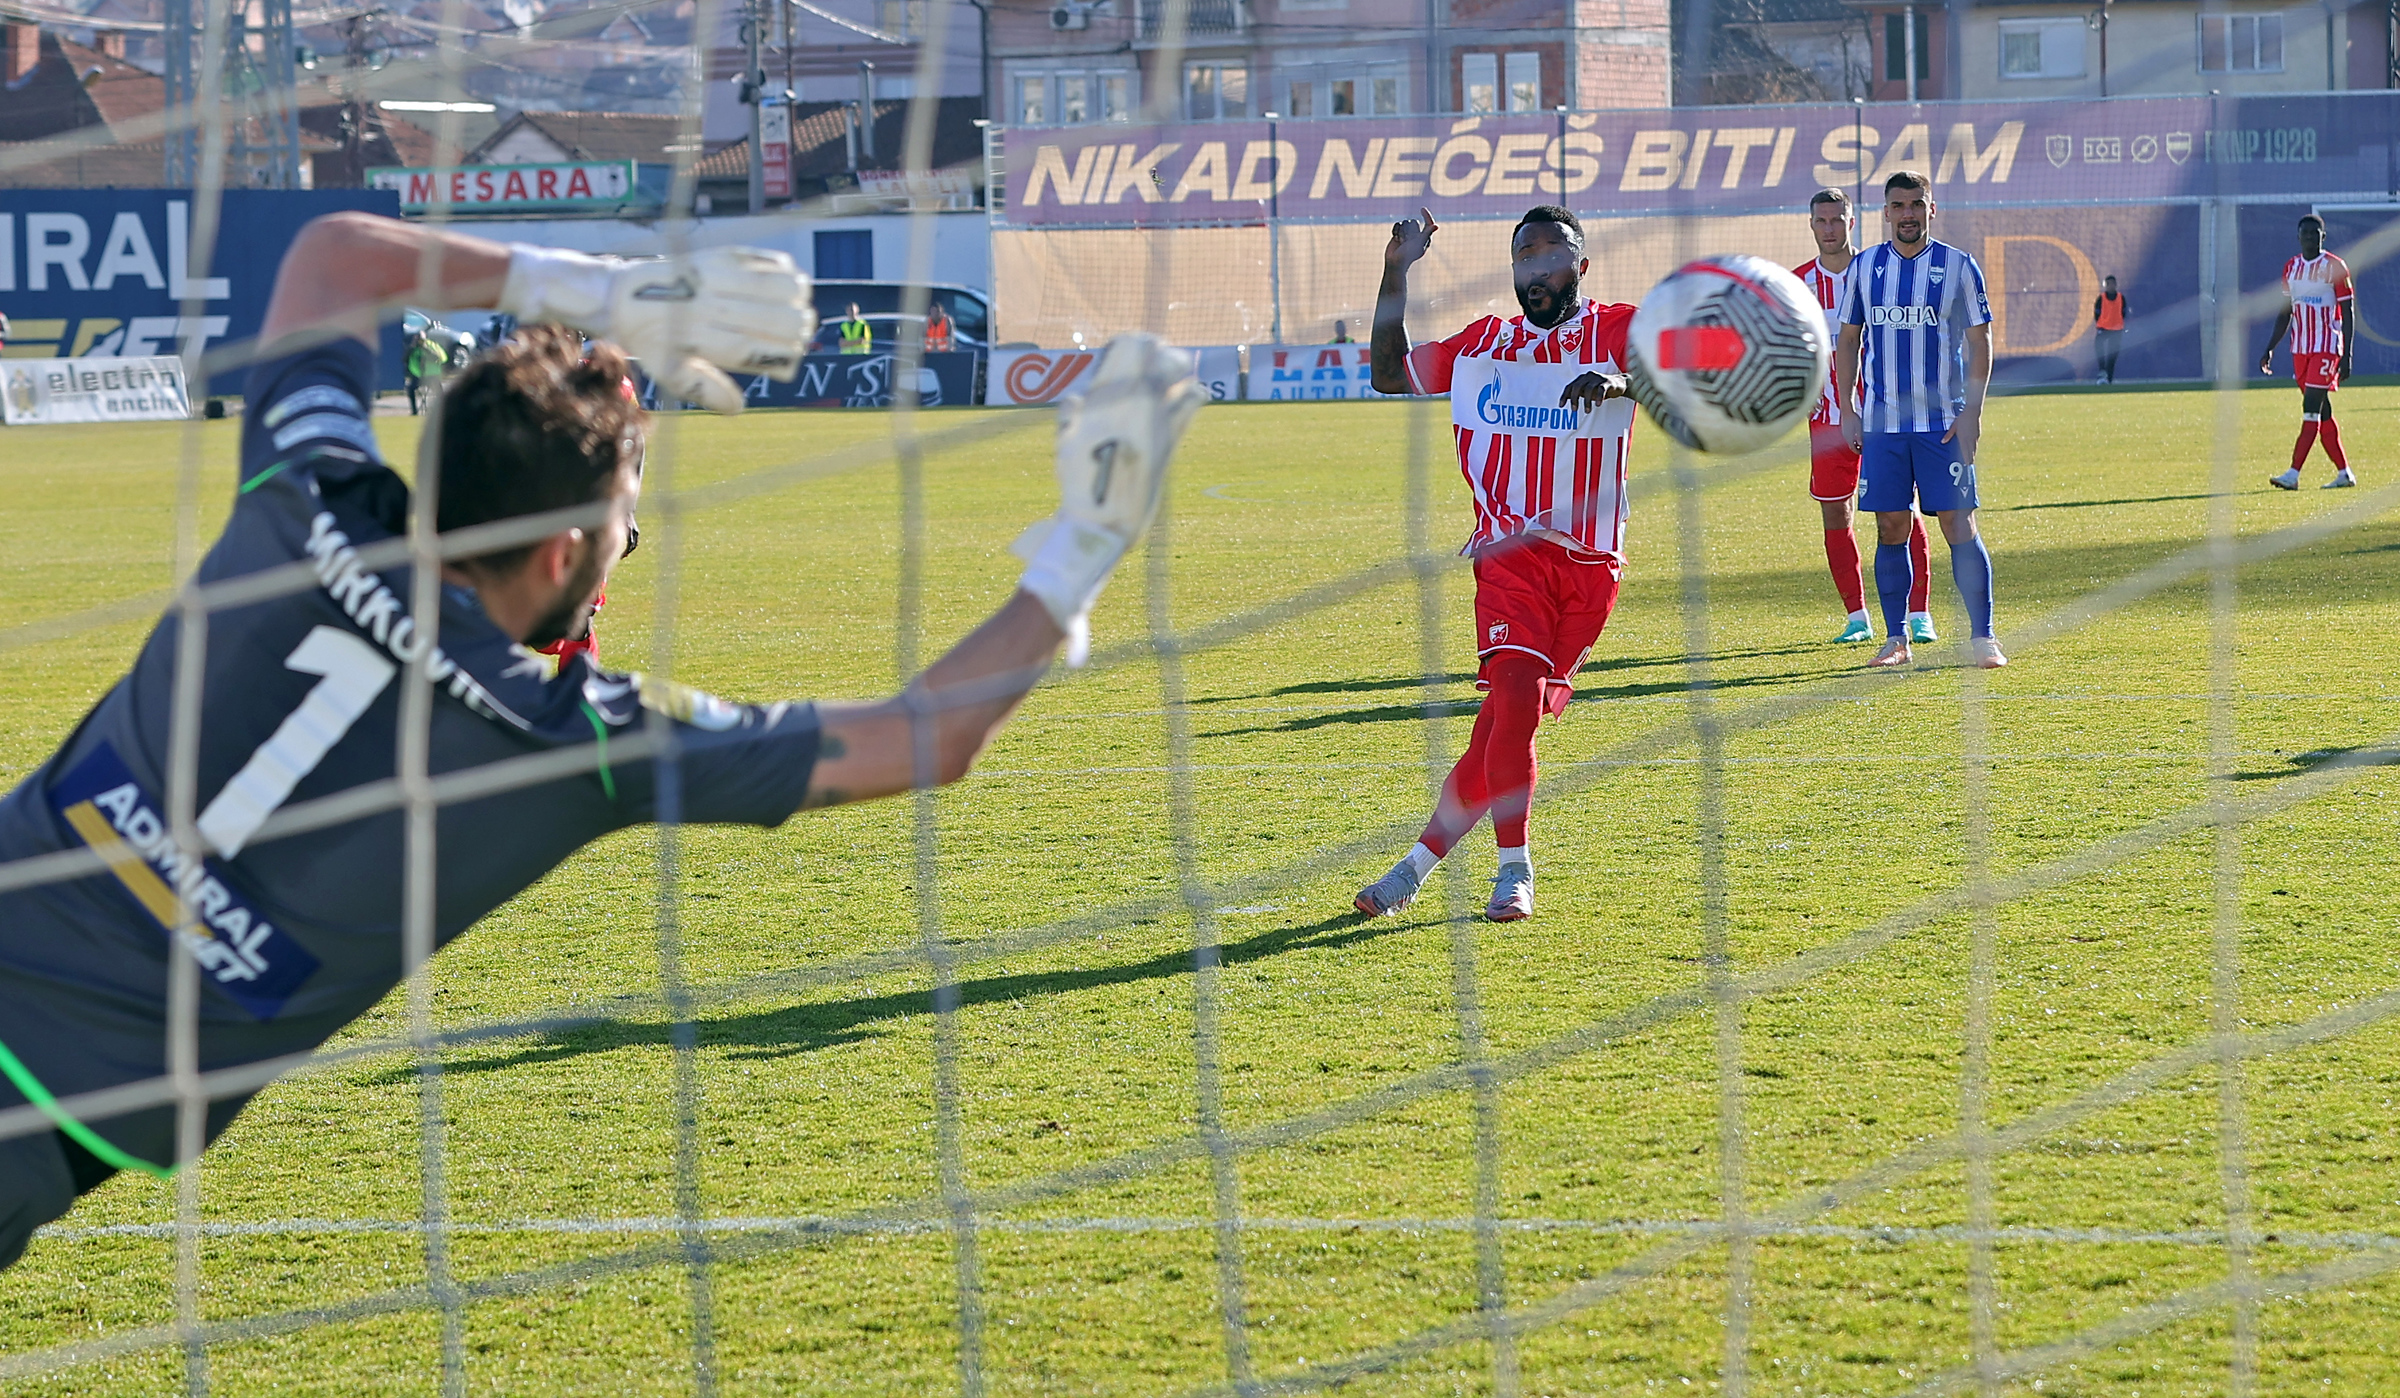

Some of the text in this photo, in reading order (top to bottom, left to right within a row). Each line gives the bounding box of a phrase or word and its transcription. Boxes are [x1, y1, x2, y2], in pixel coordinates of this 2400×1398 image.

[1022, 113, 2026, 206] NIKAD NEĆEŠ BITI SAM
[2263, 128, 2317, 163] 1928
[409, 167, 592, 204] MESARA
[1871, 306, 1938, 326] DOHA
[1889, 322, 1918, 330] GROUP
[1270, 385, 1346, 400] AUTO
[196, 623, 397, 861] 1
[94, 782, 274, 974] ADMIRAL
